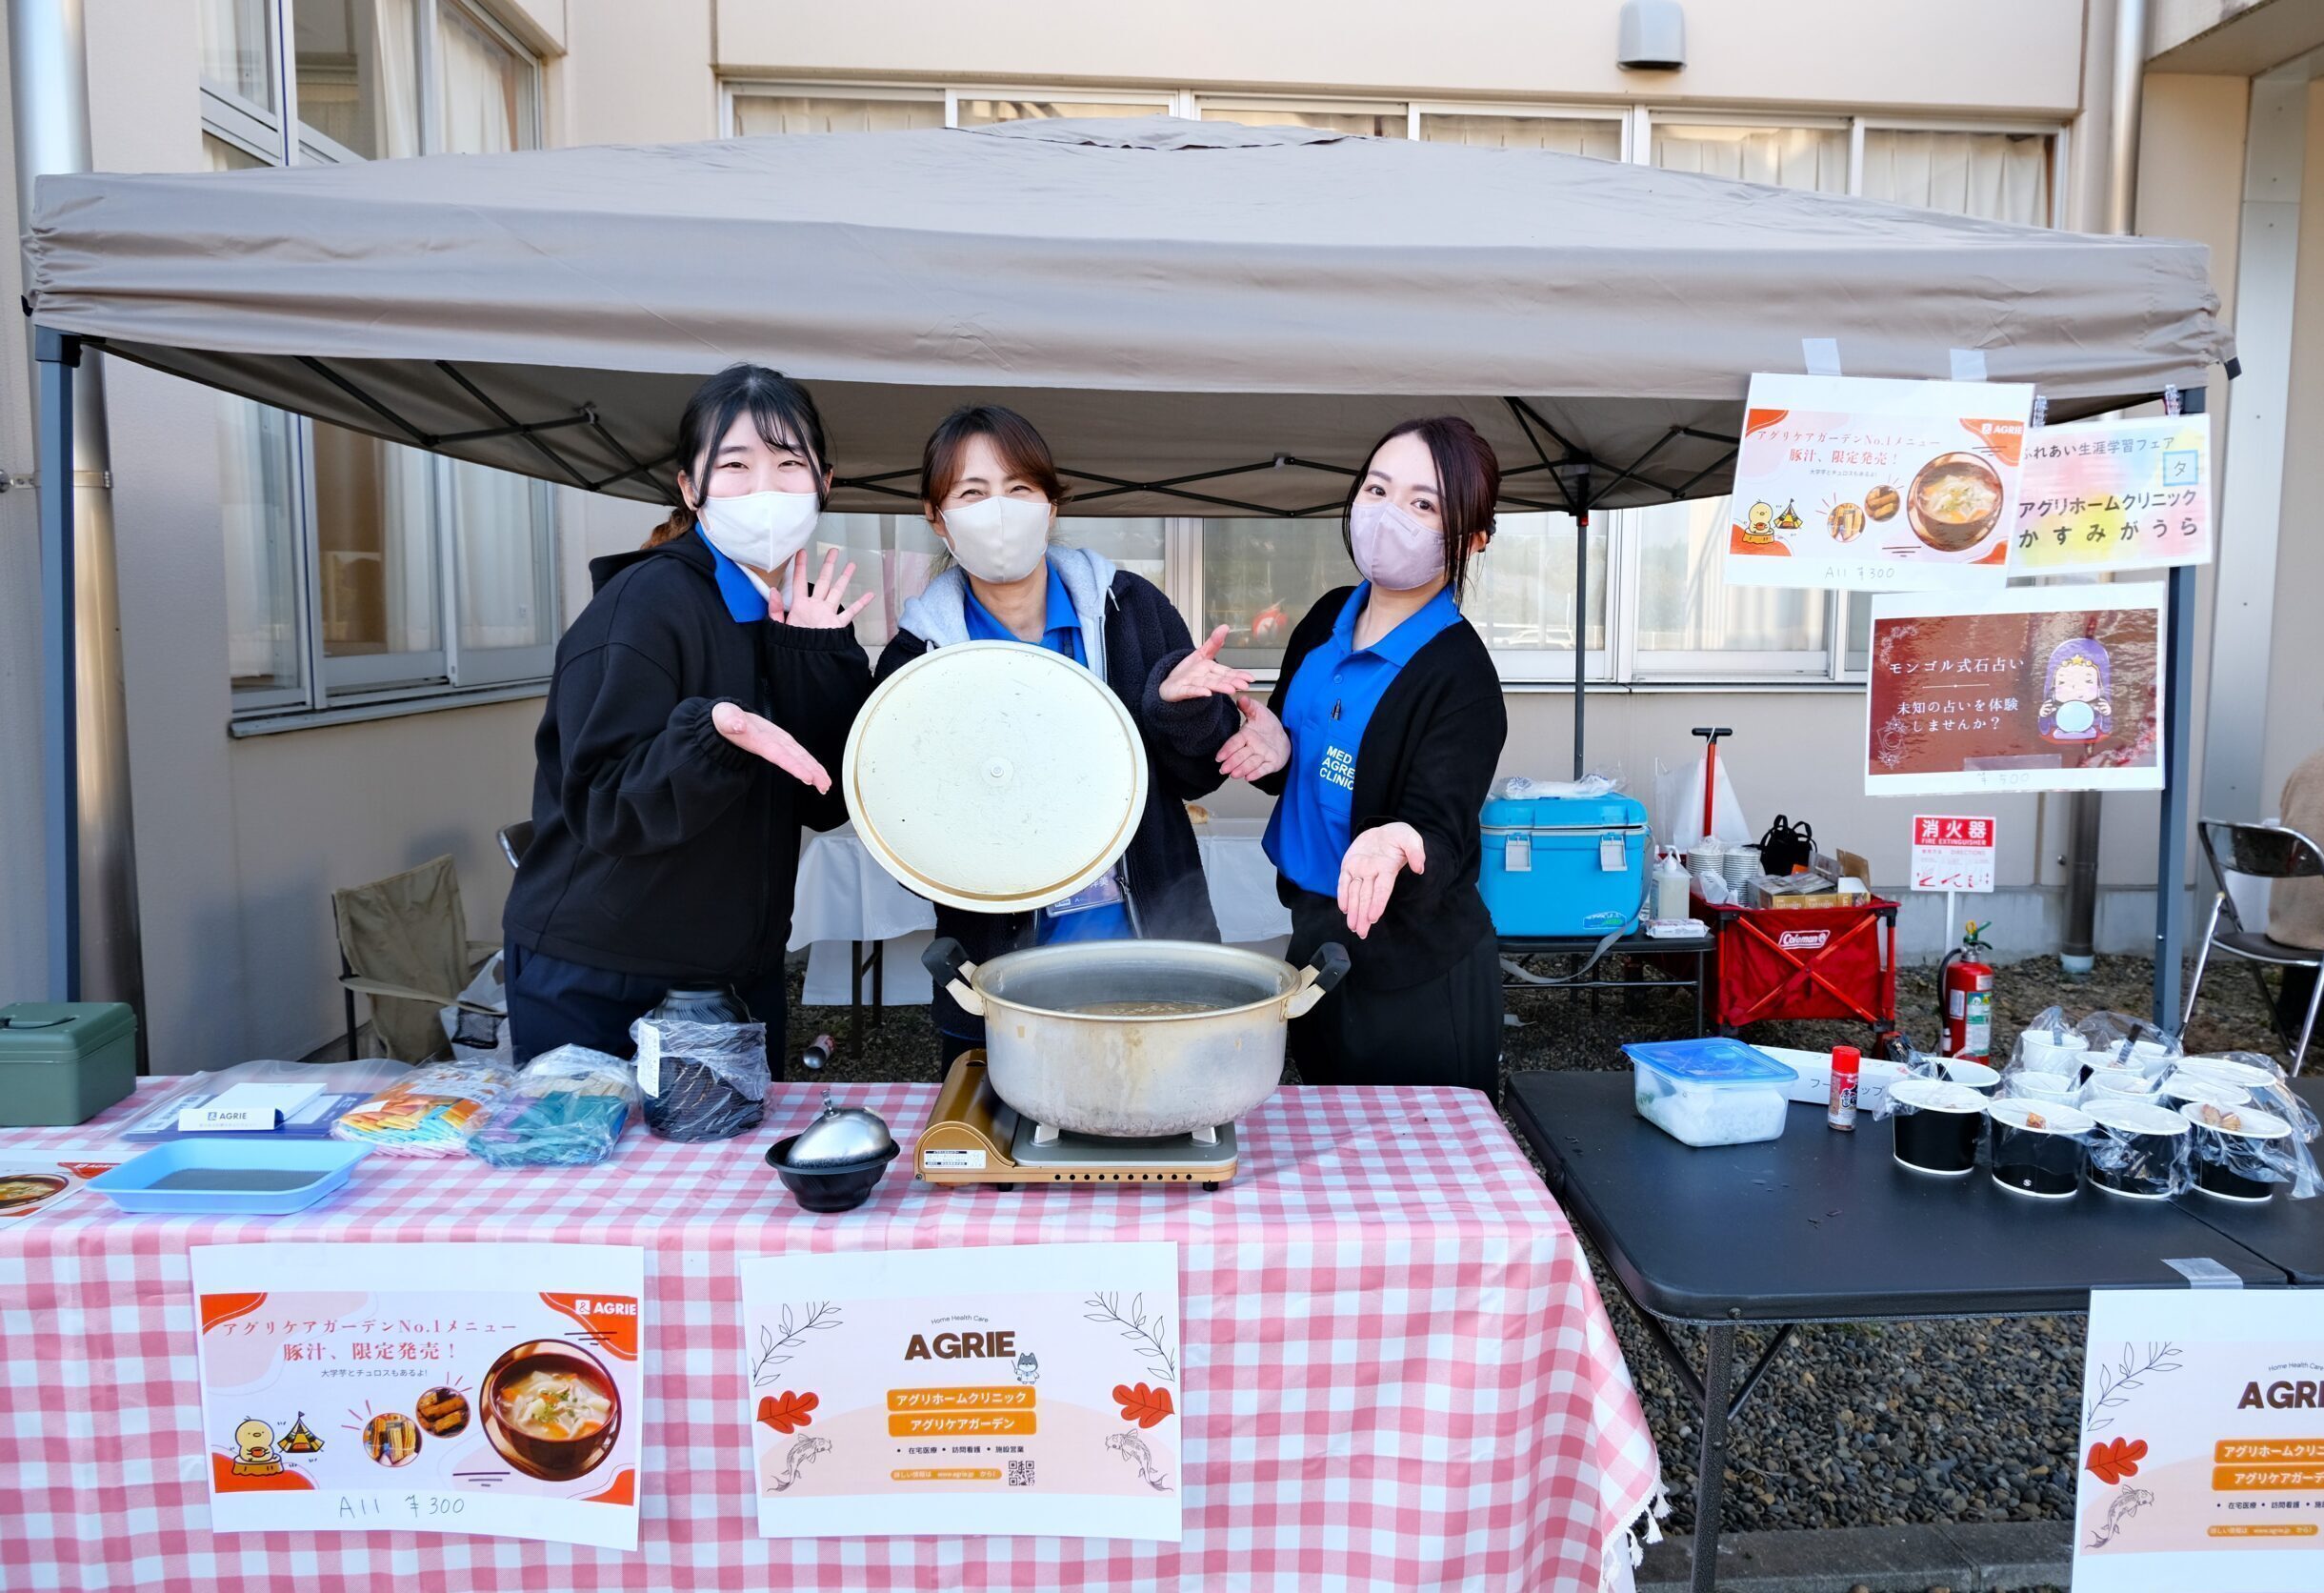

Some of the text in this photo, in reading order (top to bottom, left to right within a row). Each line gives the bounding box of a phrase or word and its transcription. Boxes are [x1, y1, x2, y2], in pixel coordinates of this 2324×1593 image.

[1993, 425, 2023, 435] AGRIE
[2018, 489, 2197, 519] アグリホームクリニック
[2018, 516, 2198, 549] かすみがうら
[1889, 656, 2025, 675] モンゴル式石占い
[1896, 697, 2019, 716] 未知の占いを体験
[1913, 716, 2000, 733] しませんか？
[1326, 745, 1352, 765] MED
[1321, 756, 1355, 780] AGRE
[1319, 767, 1354, 791] CLINIC
[1921, 818, 1987, 839] 消火器
[1782, 932, 1818, 945] Coleman
[219, 1112, 248, 1120] AGRIE
[593, 1301, 637, 1316] AGRIE
[223, 1319, 517, 1336] アグリケアガーデンNo.1メニュー
[931, 1316, 951, 1325] Home
[973, 1315, 989, 1323] Care
[283, 1341, 455, 1362] 豚汁、限定発売！
[904, 1330, 1016, 1361] AGRIE
[2268, 1363, 2288, 1372] Home
[896, 1391, 1027, 1407] アグリホームクリニック
[911, 1417, 1015, 1431] アグリケアガーデン
[908, 1446, 937, 1455] 在宅医療
[952, 1445, 981, 1454] 訪問看護
